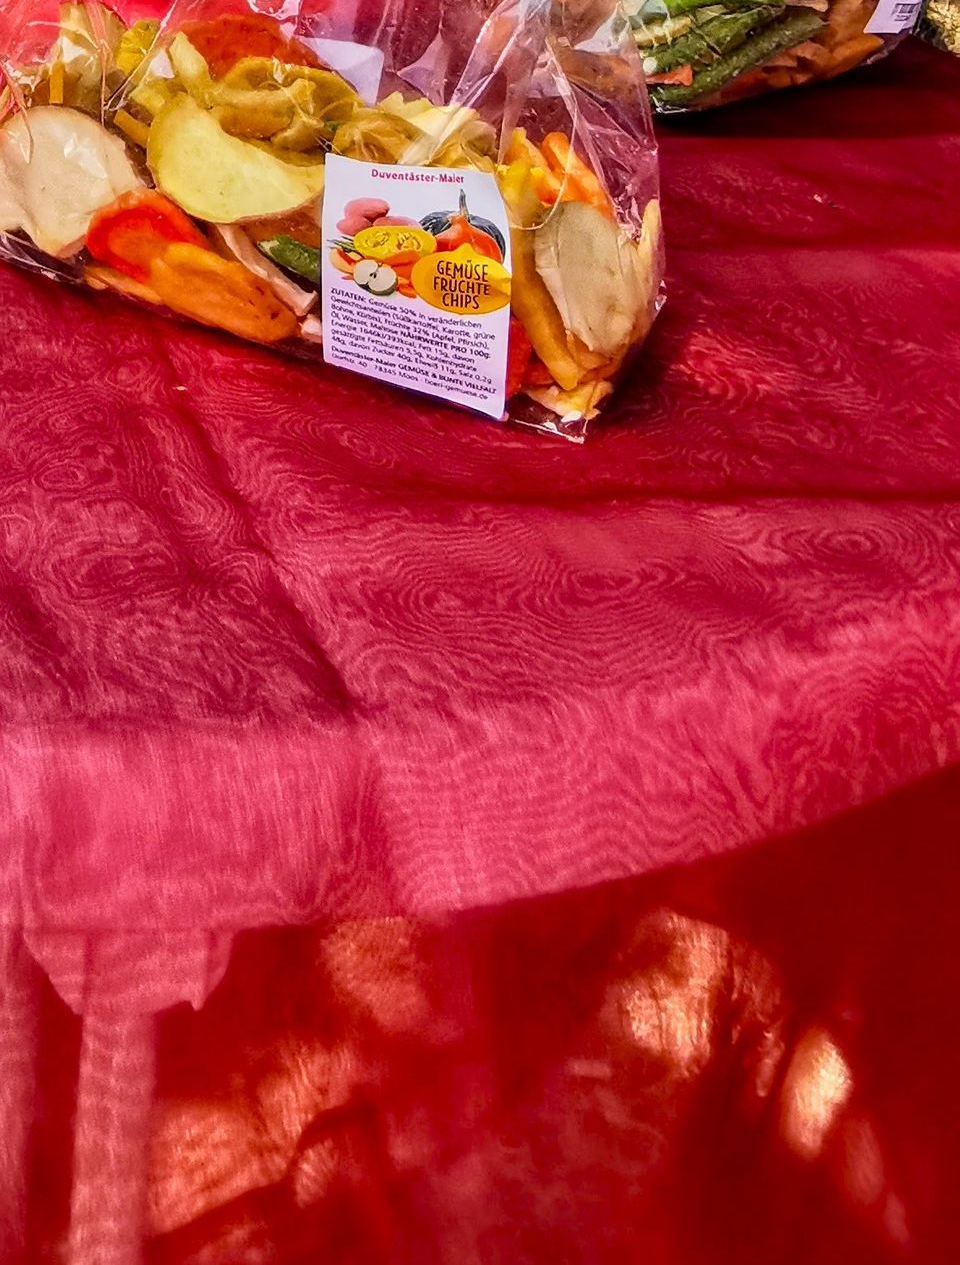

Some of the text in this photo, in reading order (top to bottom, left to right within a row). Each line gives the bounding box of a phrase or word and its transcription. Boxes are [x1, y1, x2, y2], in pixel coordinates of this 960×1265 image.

[436, 259, 489, 283] GEMÜSE
[330, 287, 367, 303] ZUTATEN:
[442, 292, 480, 310] CHIPS
[450, 345, 467, 354] PRO
